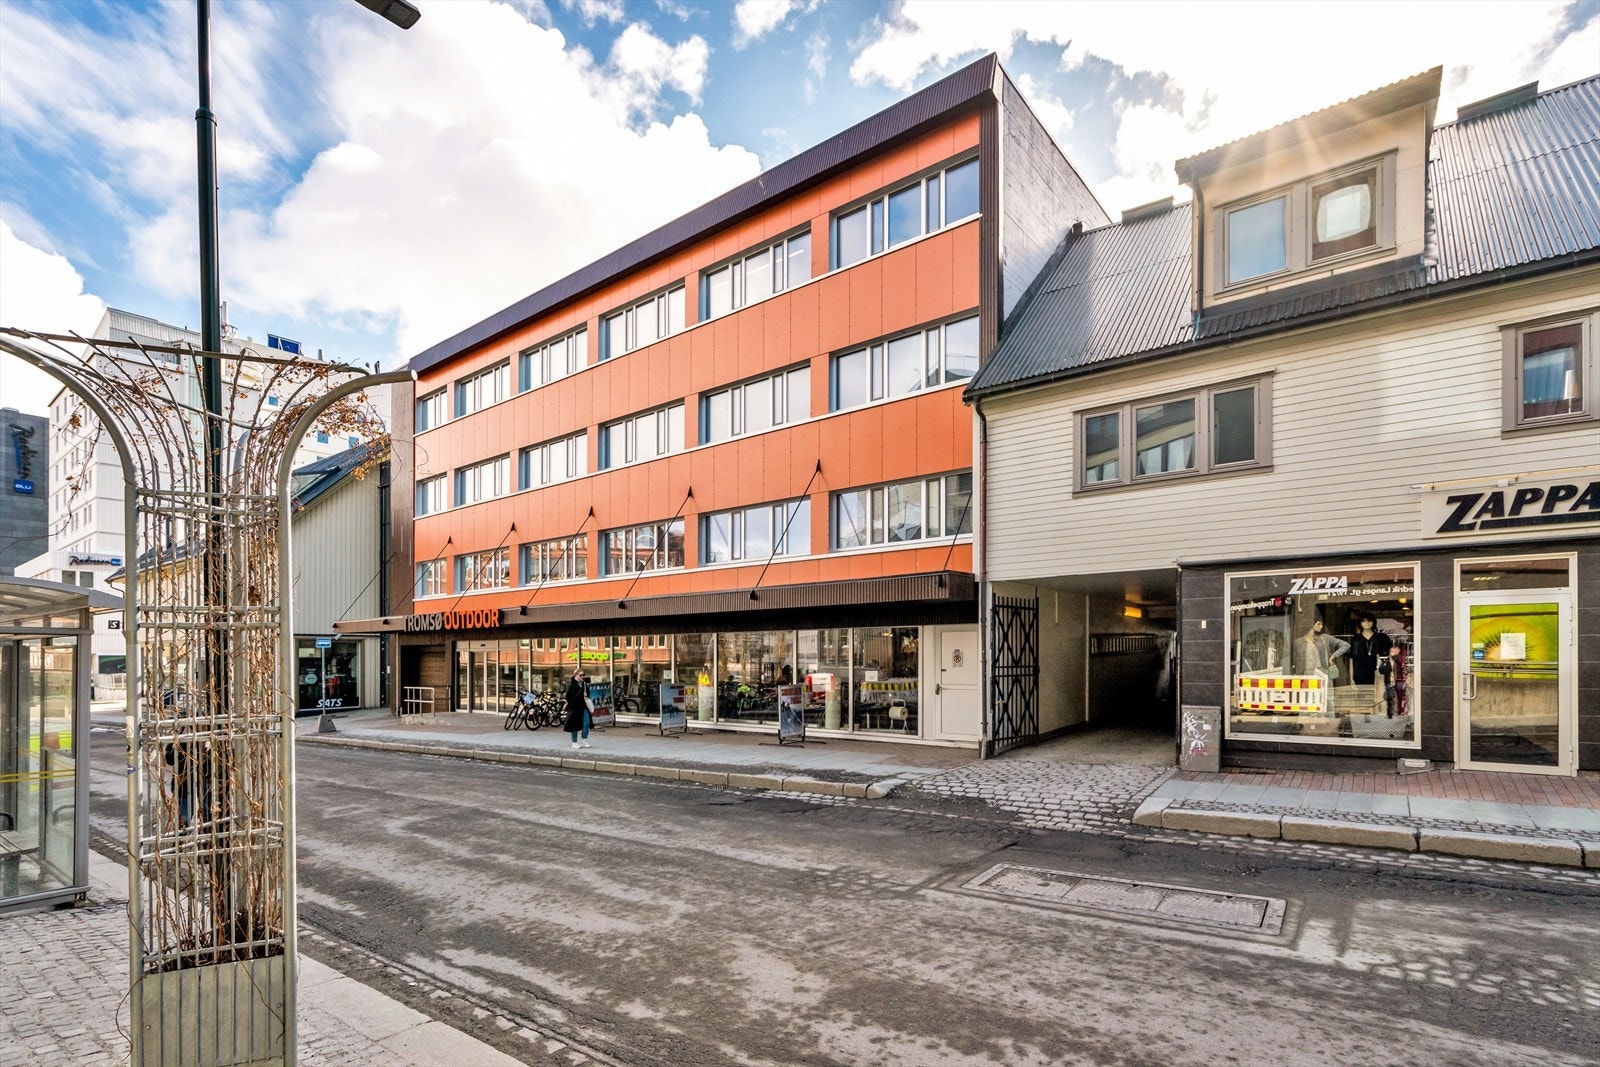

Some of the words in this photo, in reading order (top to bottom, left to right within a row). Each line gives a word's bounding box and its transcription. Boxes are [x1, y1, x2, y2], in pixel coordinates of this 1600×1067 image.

[1436, 482, 1600, 533] ZAPPA
[1288, 576, 1348, 595] ZAPPA
[404, 612, 443, 632] TROMSØ
[444, 608, 500, 630] OUTDOOR
[316, 698, 343, 708] SATS
